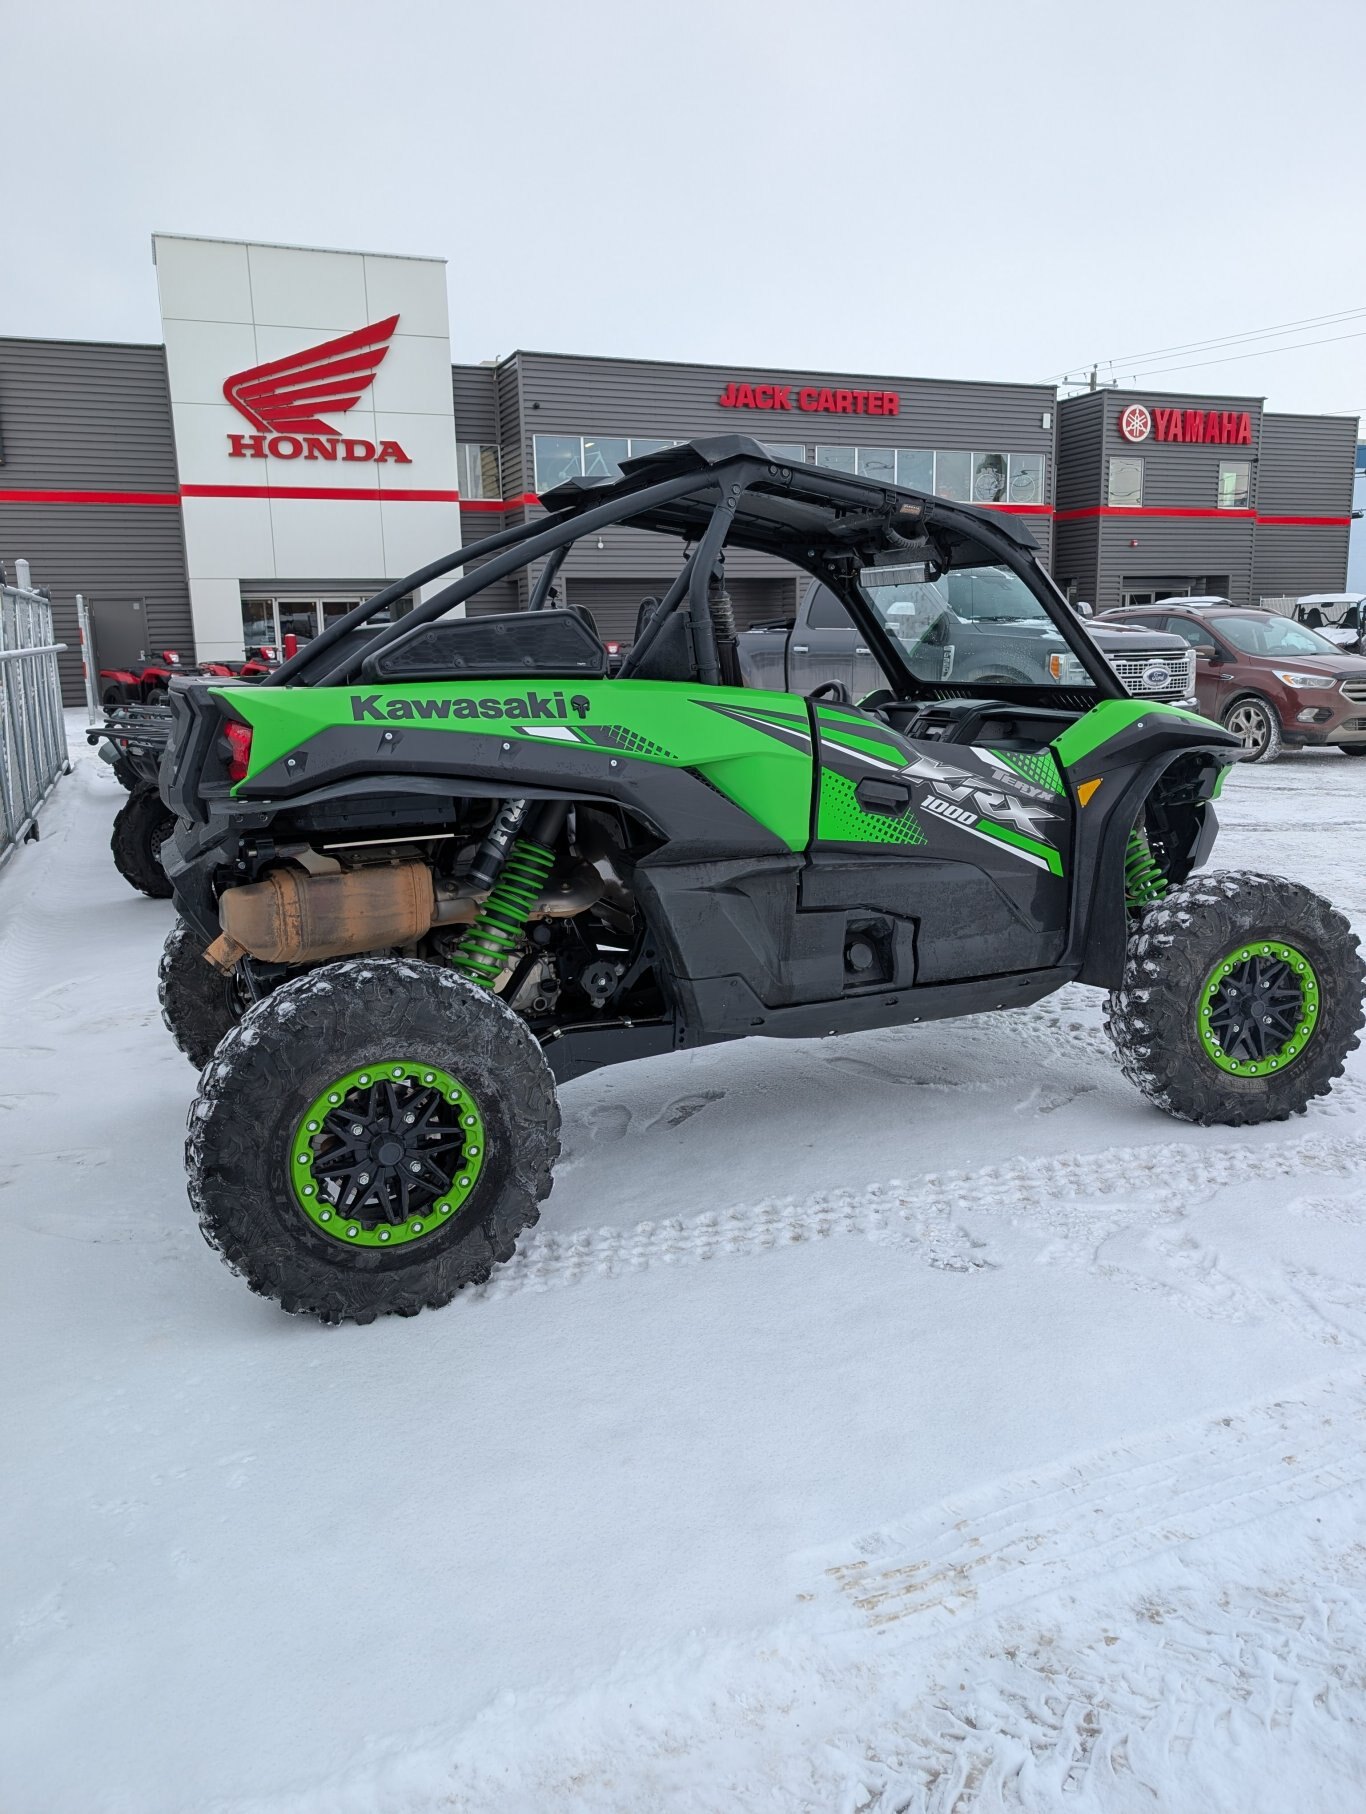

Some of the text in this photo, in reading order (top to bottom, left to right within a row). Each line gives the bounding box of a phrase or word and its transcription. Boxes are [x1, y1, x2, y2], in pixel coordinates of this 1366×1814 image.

[720, 382, 900, 416] JACK CARTER
[1152, 407, 1252, 445] YAMAHA
[227, 434, 412, 463] HONDA
[350, 691, 568, 721] Kawasaki
[487, 798, 528, 846] FOX
[919, 795, 978, 825] 1000
